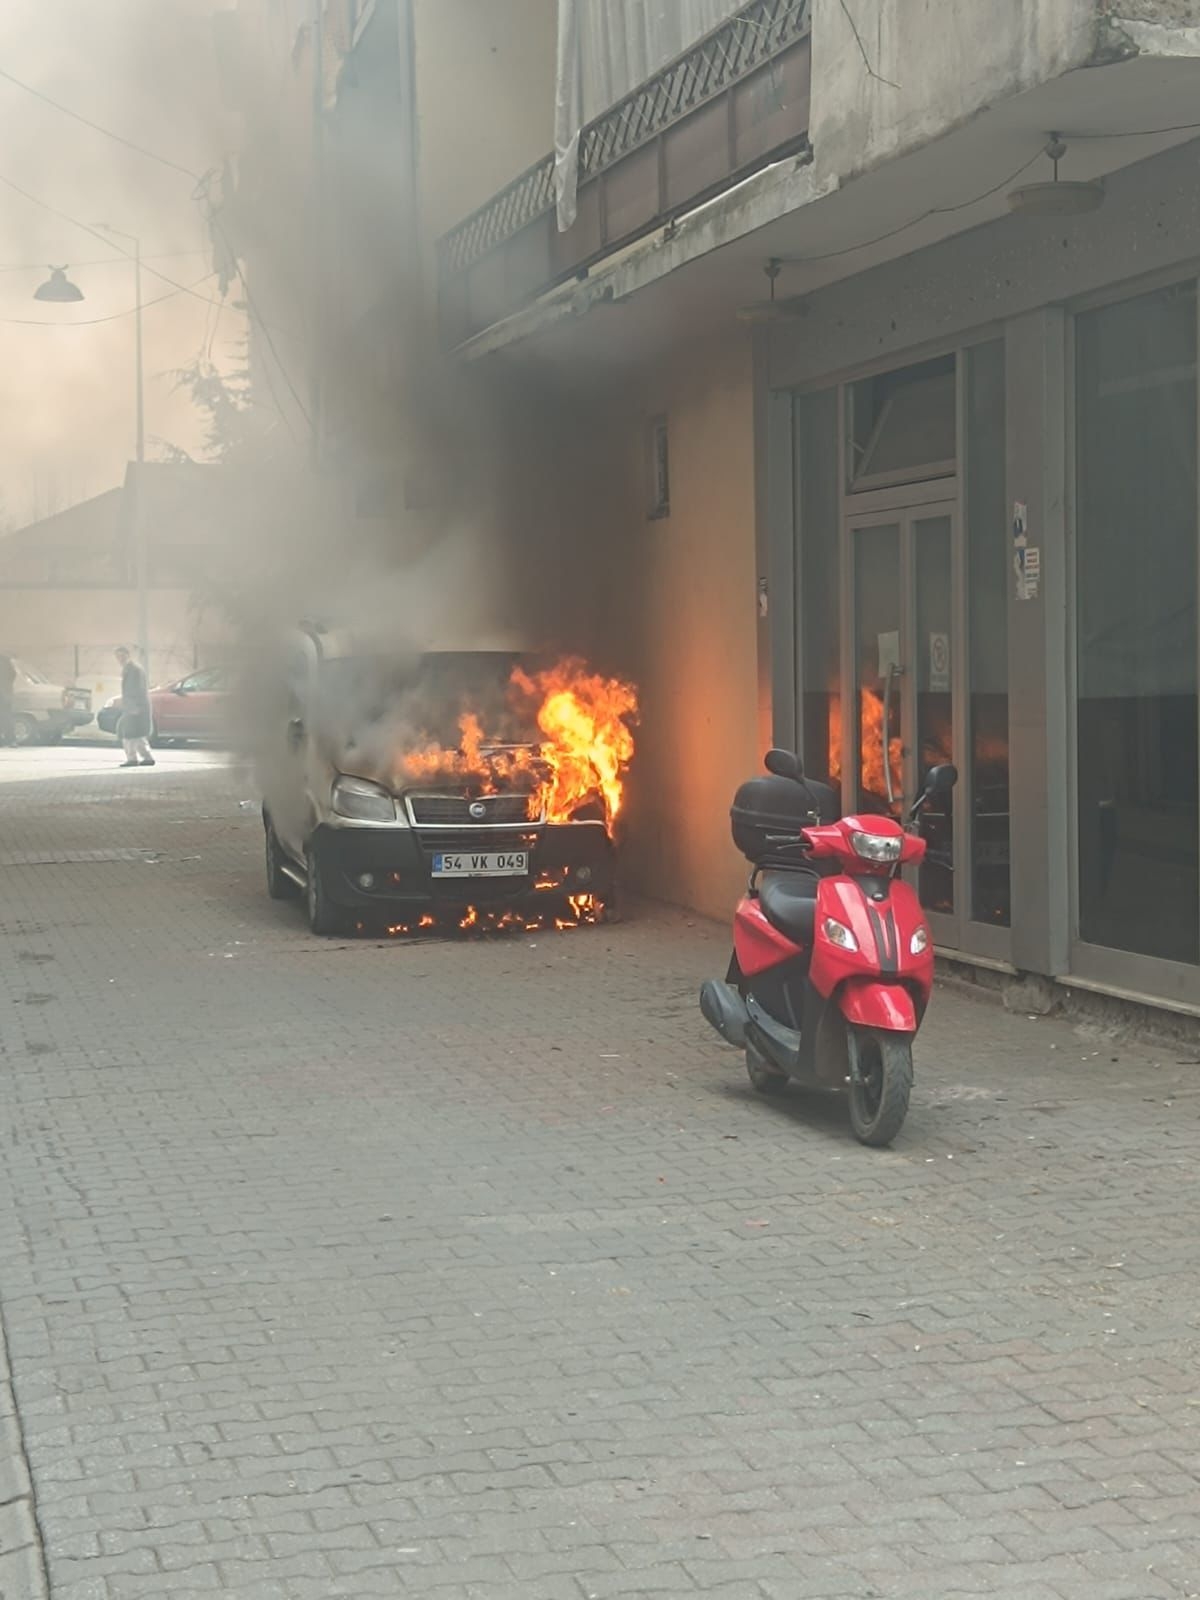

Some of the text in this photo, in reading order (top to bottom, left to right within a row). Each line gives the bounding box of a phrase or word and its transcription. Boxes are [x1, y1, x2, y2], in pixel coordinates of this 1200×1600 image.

[443, 856, 462, 870] 54
[471, 855, 488, 869] VK
[497, 854, 524, 869] 049
